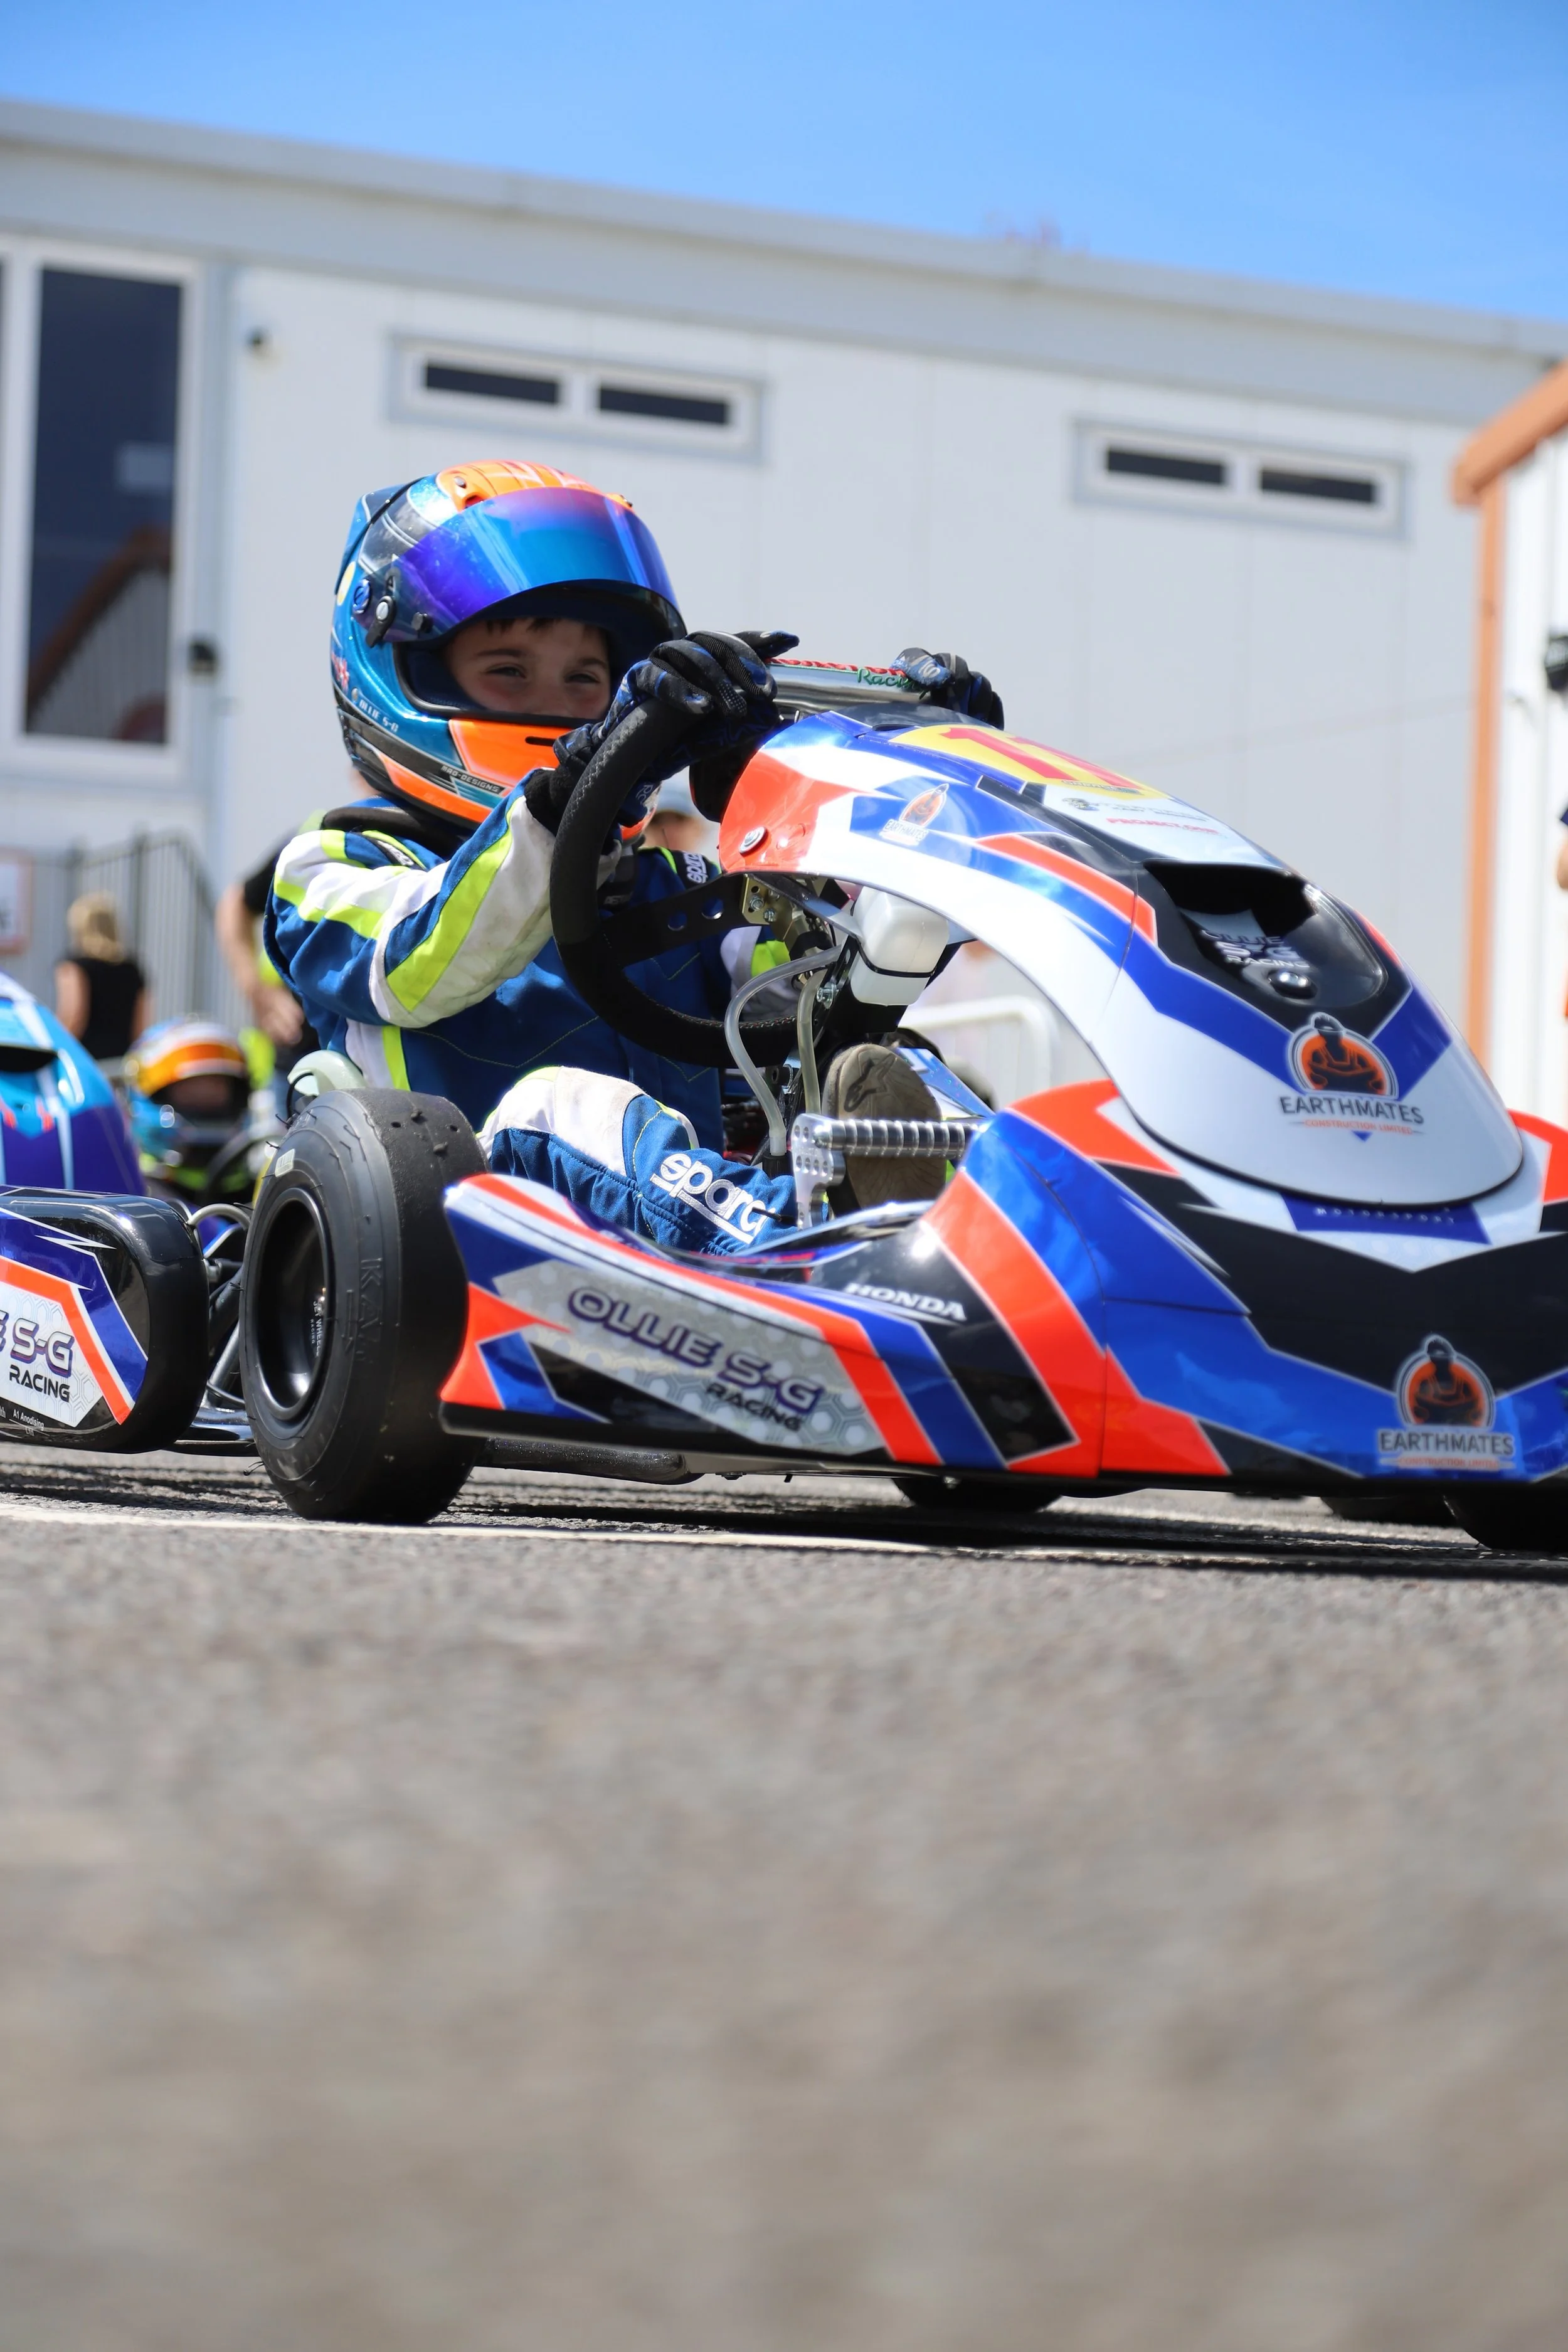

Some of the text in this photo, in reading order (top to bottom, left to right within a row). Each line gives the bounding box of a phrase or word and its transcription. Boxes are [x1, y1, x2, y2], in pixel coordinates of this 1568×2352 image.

[940, 727, 1143, 790] 11
[441, 765, 501, 792] MAD-DESIGNS
[1226, 954, 1310, 968] RACING
[1279, 1096, 1424, 1125] EARTHMATES
[1304, 1119, 1414, 1135] CONSTRUCTION LIMITED
[650, 1153, 776, 1244] sparc
[1316, 1206, 1455, 1224] MOTORSPORT
[845, 1282, 967, 1322] HONDA
[10, 1317, 75, 1379] S-G
[568, 1286, 824, 1414] OLLIE S-G
[9, 1364, 70, 1403] RACING
[13, 1409, 20, 1419] A1
[20, 1412, 45, 1431] Anodising
[707, 1383, 804, 1433] RACING
[1380, 1431, 1515, 1456] EARTHMATES
